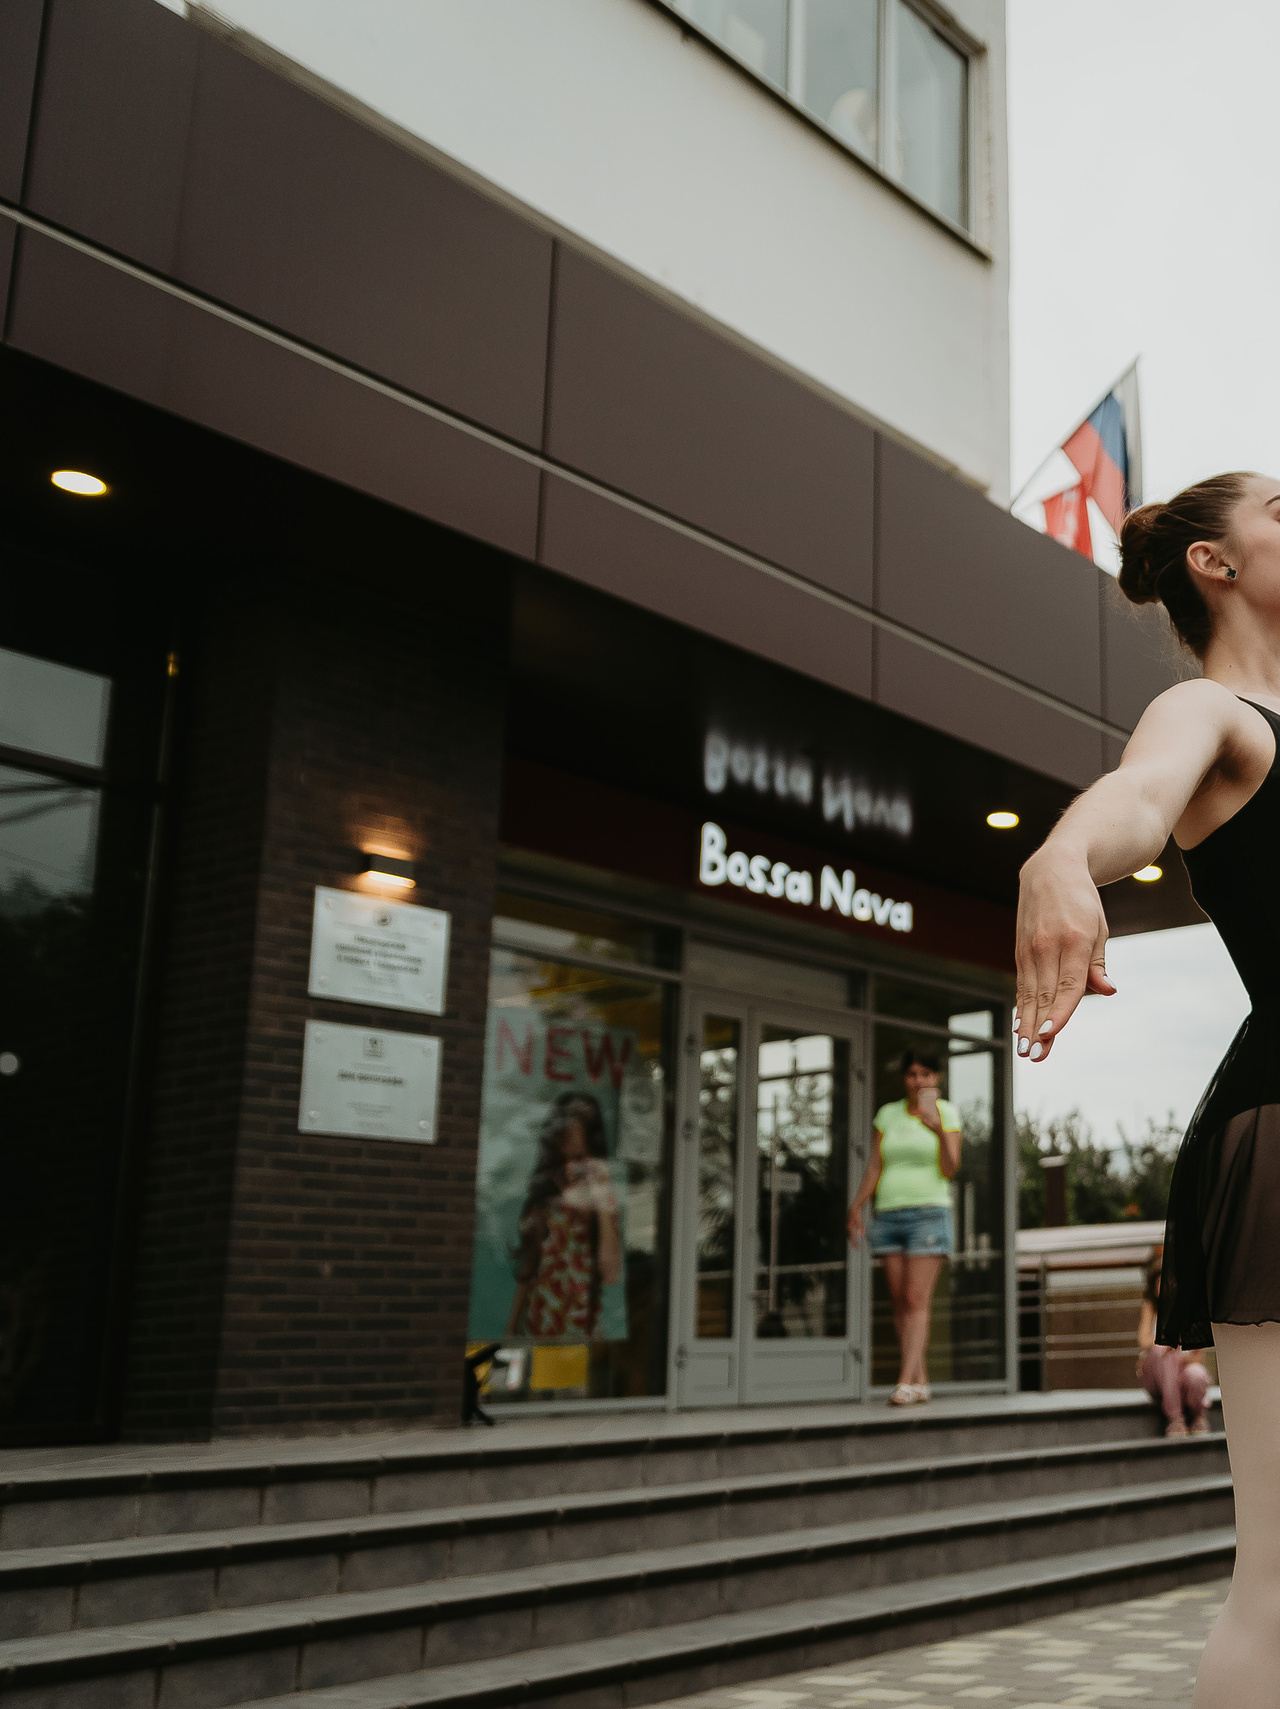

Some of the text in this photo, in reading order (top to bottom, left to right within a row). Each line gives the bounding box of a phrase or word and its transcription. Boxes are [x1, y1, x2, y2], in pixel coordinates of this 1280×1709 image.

[699, 821, 914, 933] Bossa Nova
[494, 1017, 633, 1088] NEW
